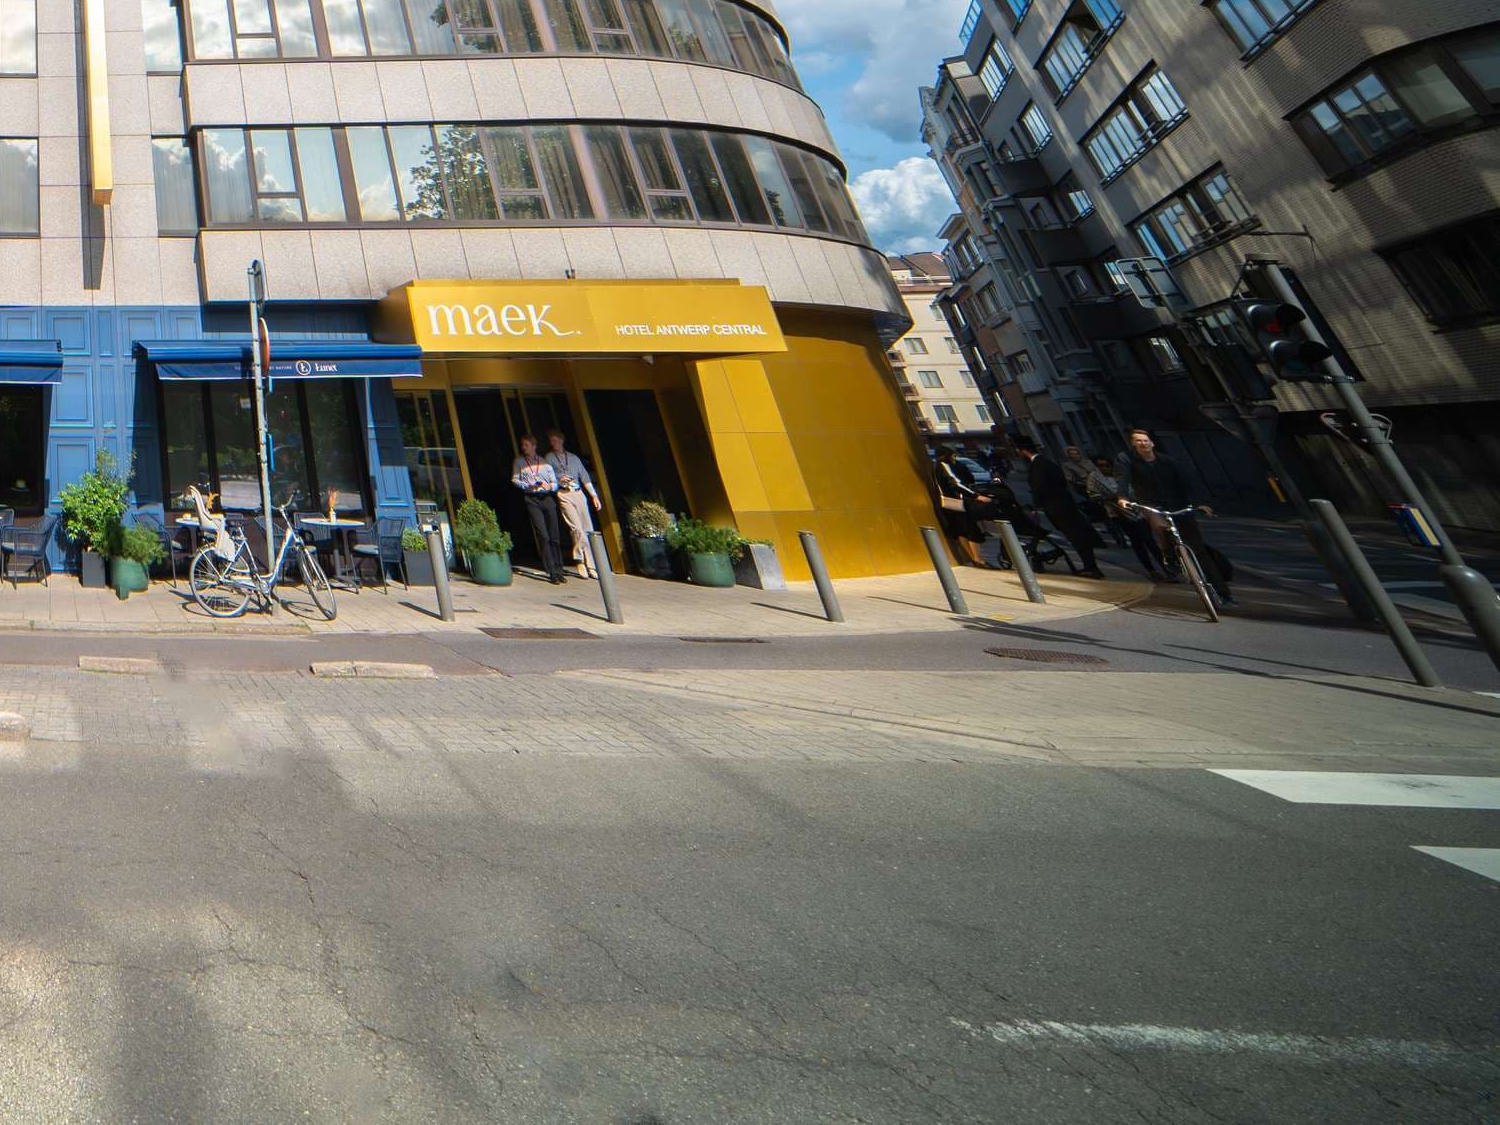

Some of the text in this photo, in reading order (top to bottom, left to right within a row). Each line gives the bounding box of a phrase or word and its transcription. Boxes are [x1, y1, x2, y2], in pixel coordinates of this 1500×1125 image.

[614, 324, 767, 335] HOTEL ANTWERP CENTRAL
